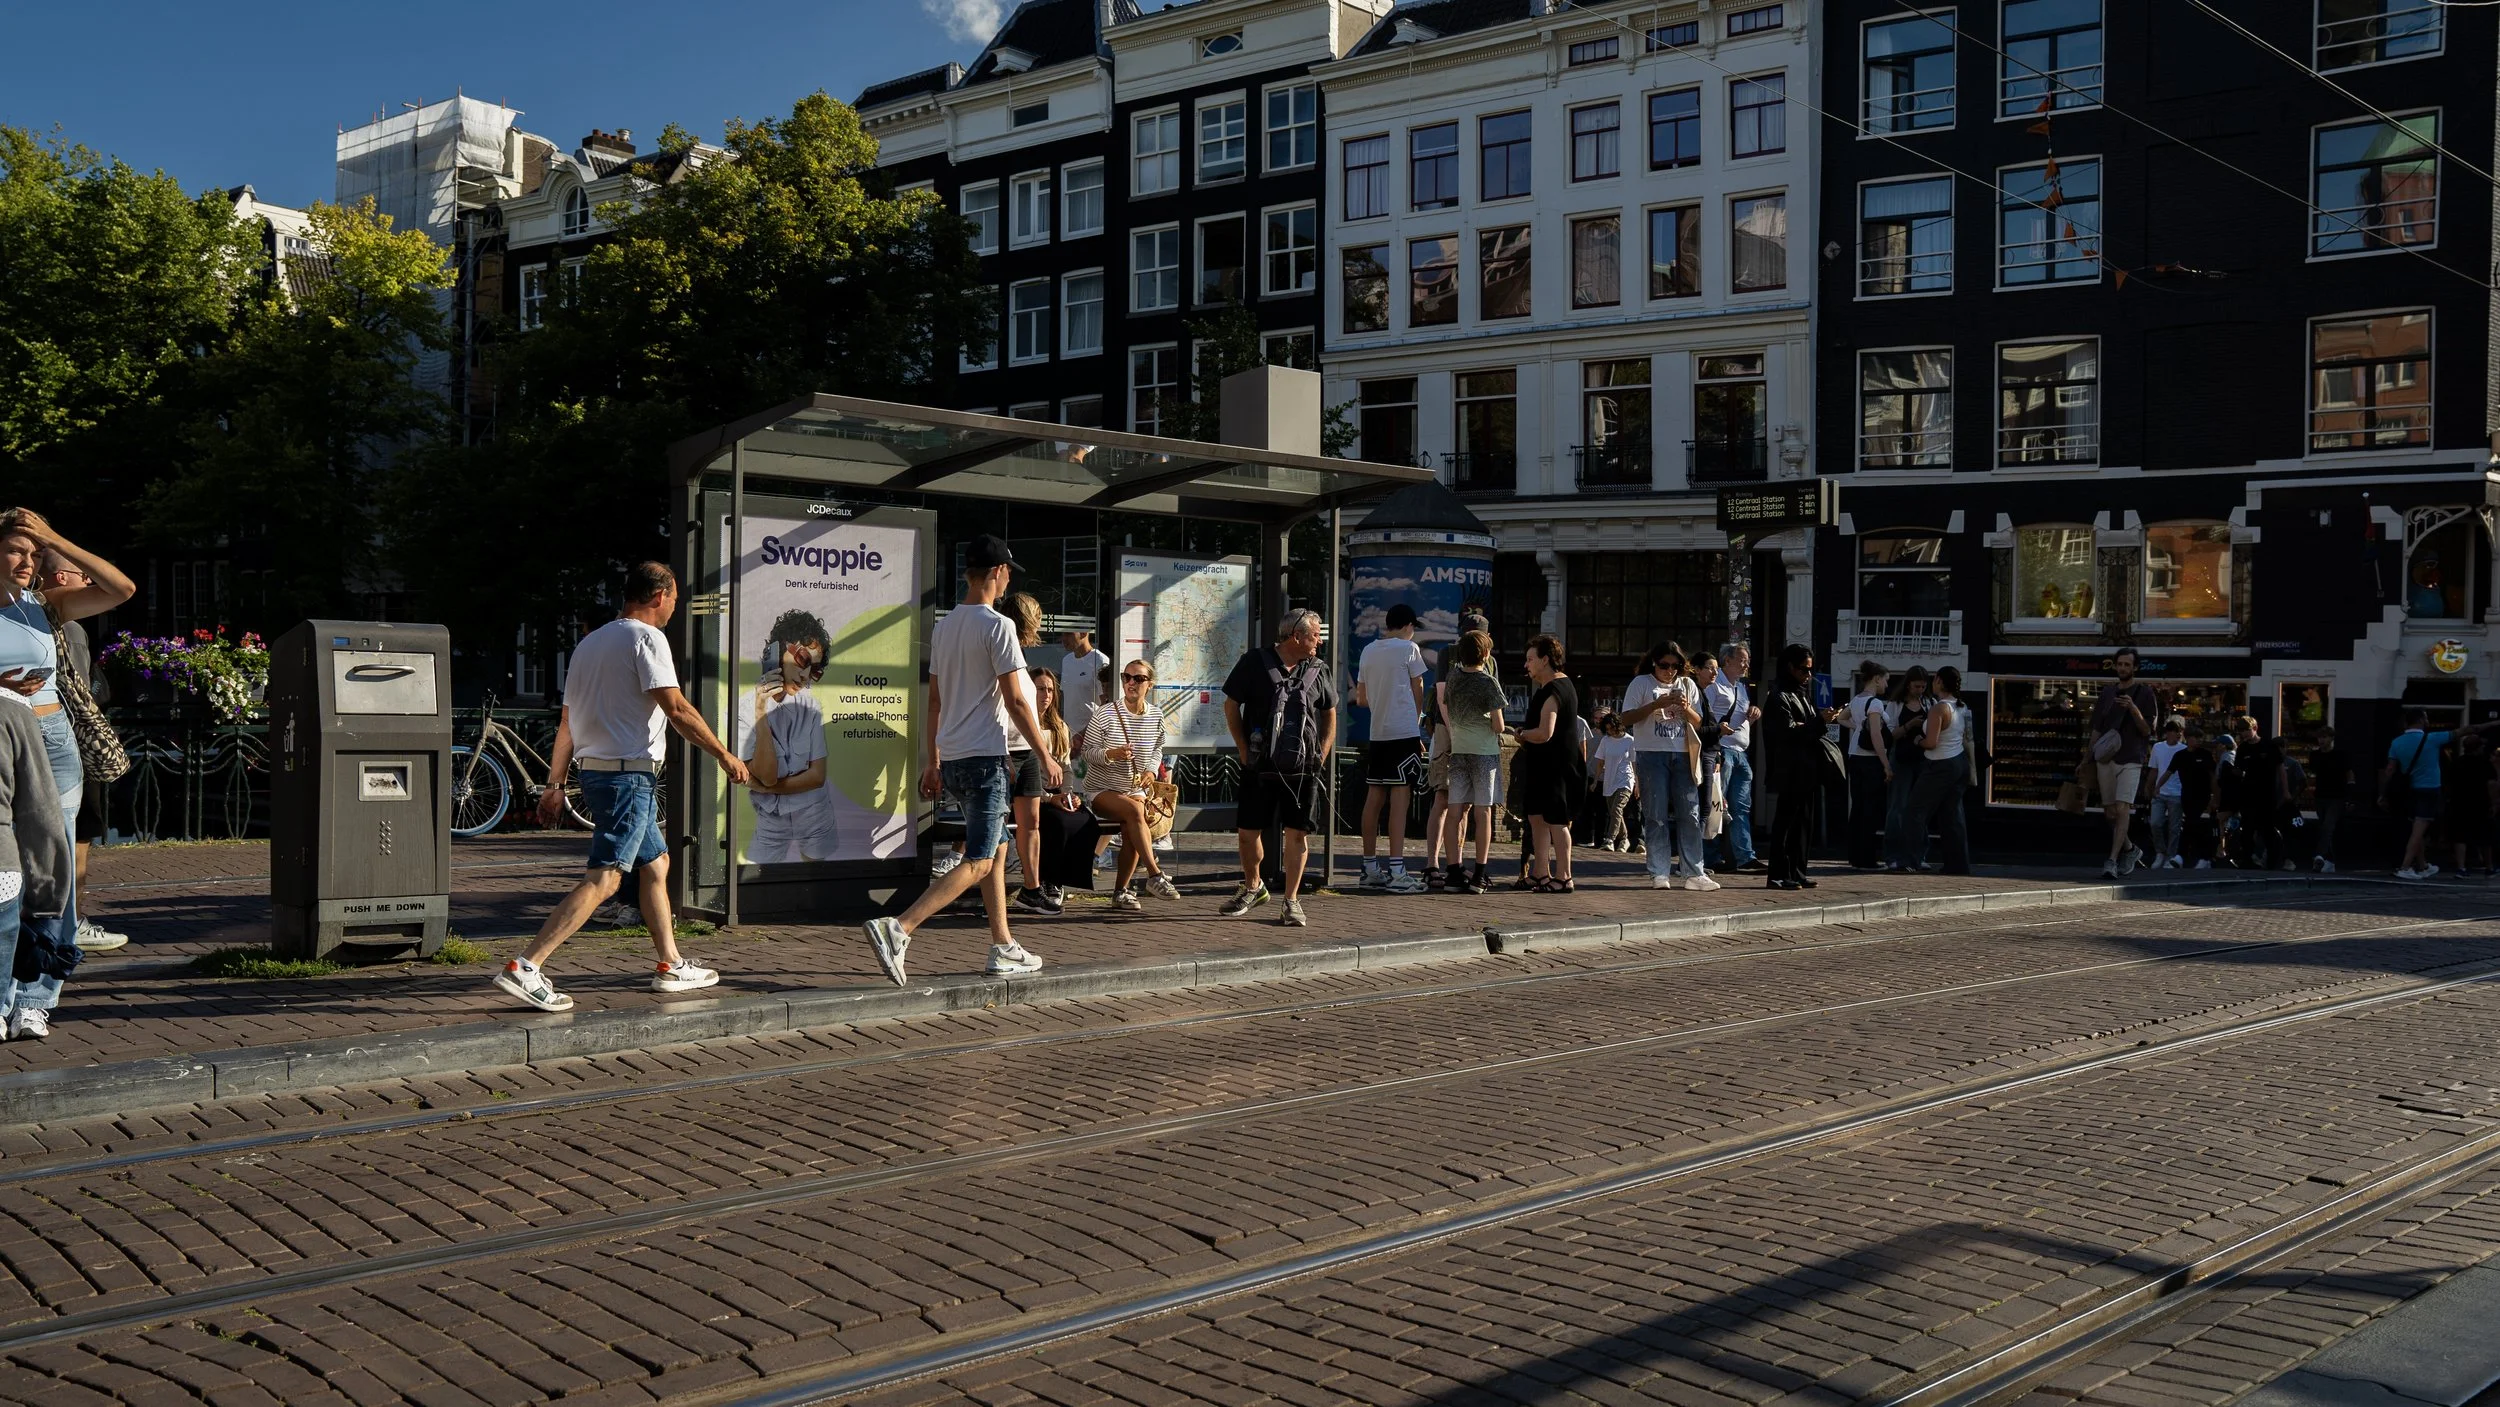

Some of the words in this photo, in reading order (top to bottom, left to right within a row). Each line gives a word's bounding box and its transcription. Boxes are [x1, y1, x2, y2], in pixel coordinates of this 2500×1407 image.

[1735, 497, 1761, 505] Centraal
[1762, 503, 1785, 511] Station
[806, 504, 852, 517] JCDecaux
[1735, 512, 1761, 520] Centraal
[761, 535, 883, 576] Swappie
[1173, 562, 1228, 574] Keizersgracht
[785, 578, 808, 590] Denk
[809, 579, 859, 592] refurbished
[854, 674, 888, 691] Koop
[839, 695, 858, 704] van
[861, 693, 902, 706] Europa's
[832, 711, 874, 725] grootste
[875, 710, 909, 722] iPhone
[843, 727, 897, 739] refurbisher
[344, 905, 371, 913] PUSH
[376, 904, 391, 912] ME
[396, 903, 425, 911] DOWN
